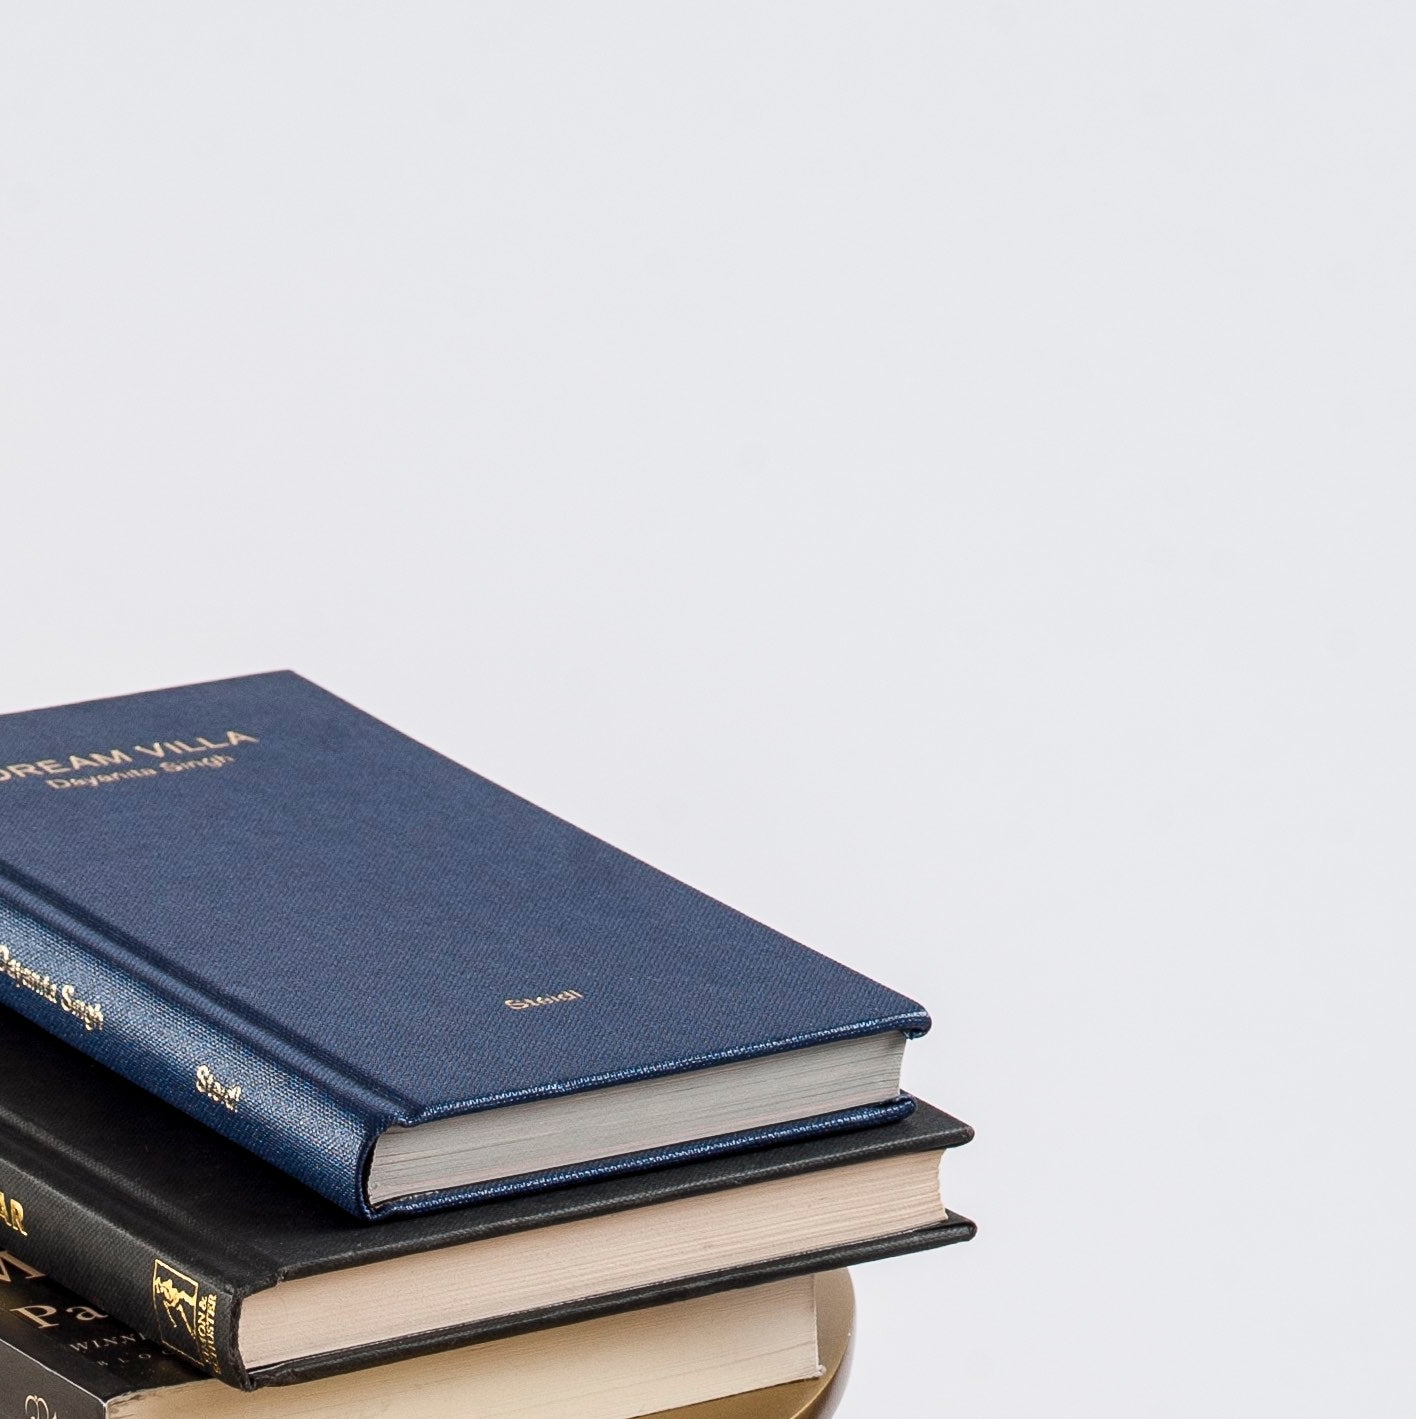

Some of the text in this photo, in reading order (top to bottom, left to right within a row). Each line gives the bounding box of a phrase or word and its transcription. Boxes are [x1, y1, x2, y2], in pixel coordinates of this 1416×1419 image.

[134, 730, 259, 759] VILLA
[46, 753, 235, 790] Dayanita Singh
[505, 989, 584, 1010] Steidl
[10, 1304, 109, 1329] Pa
